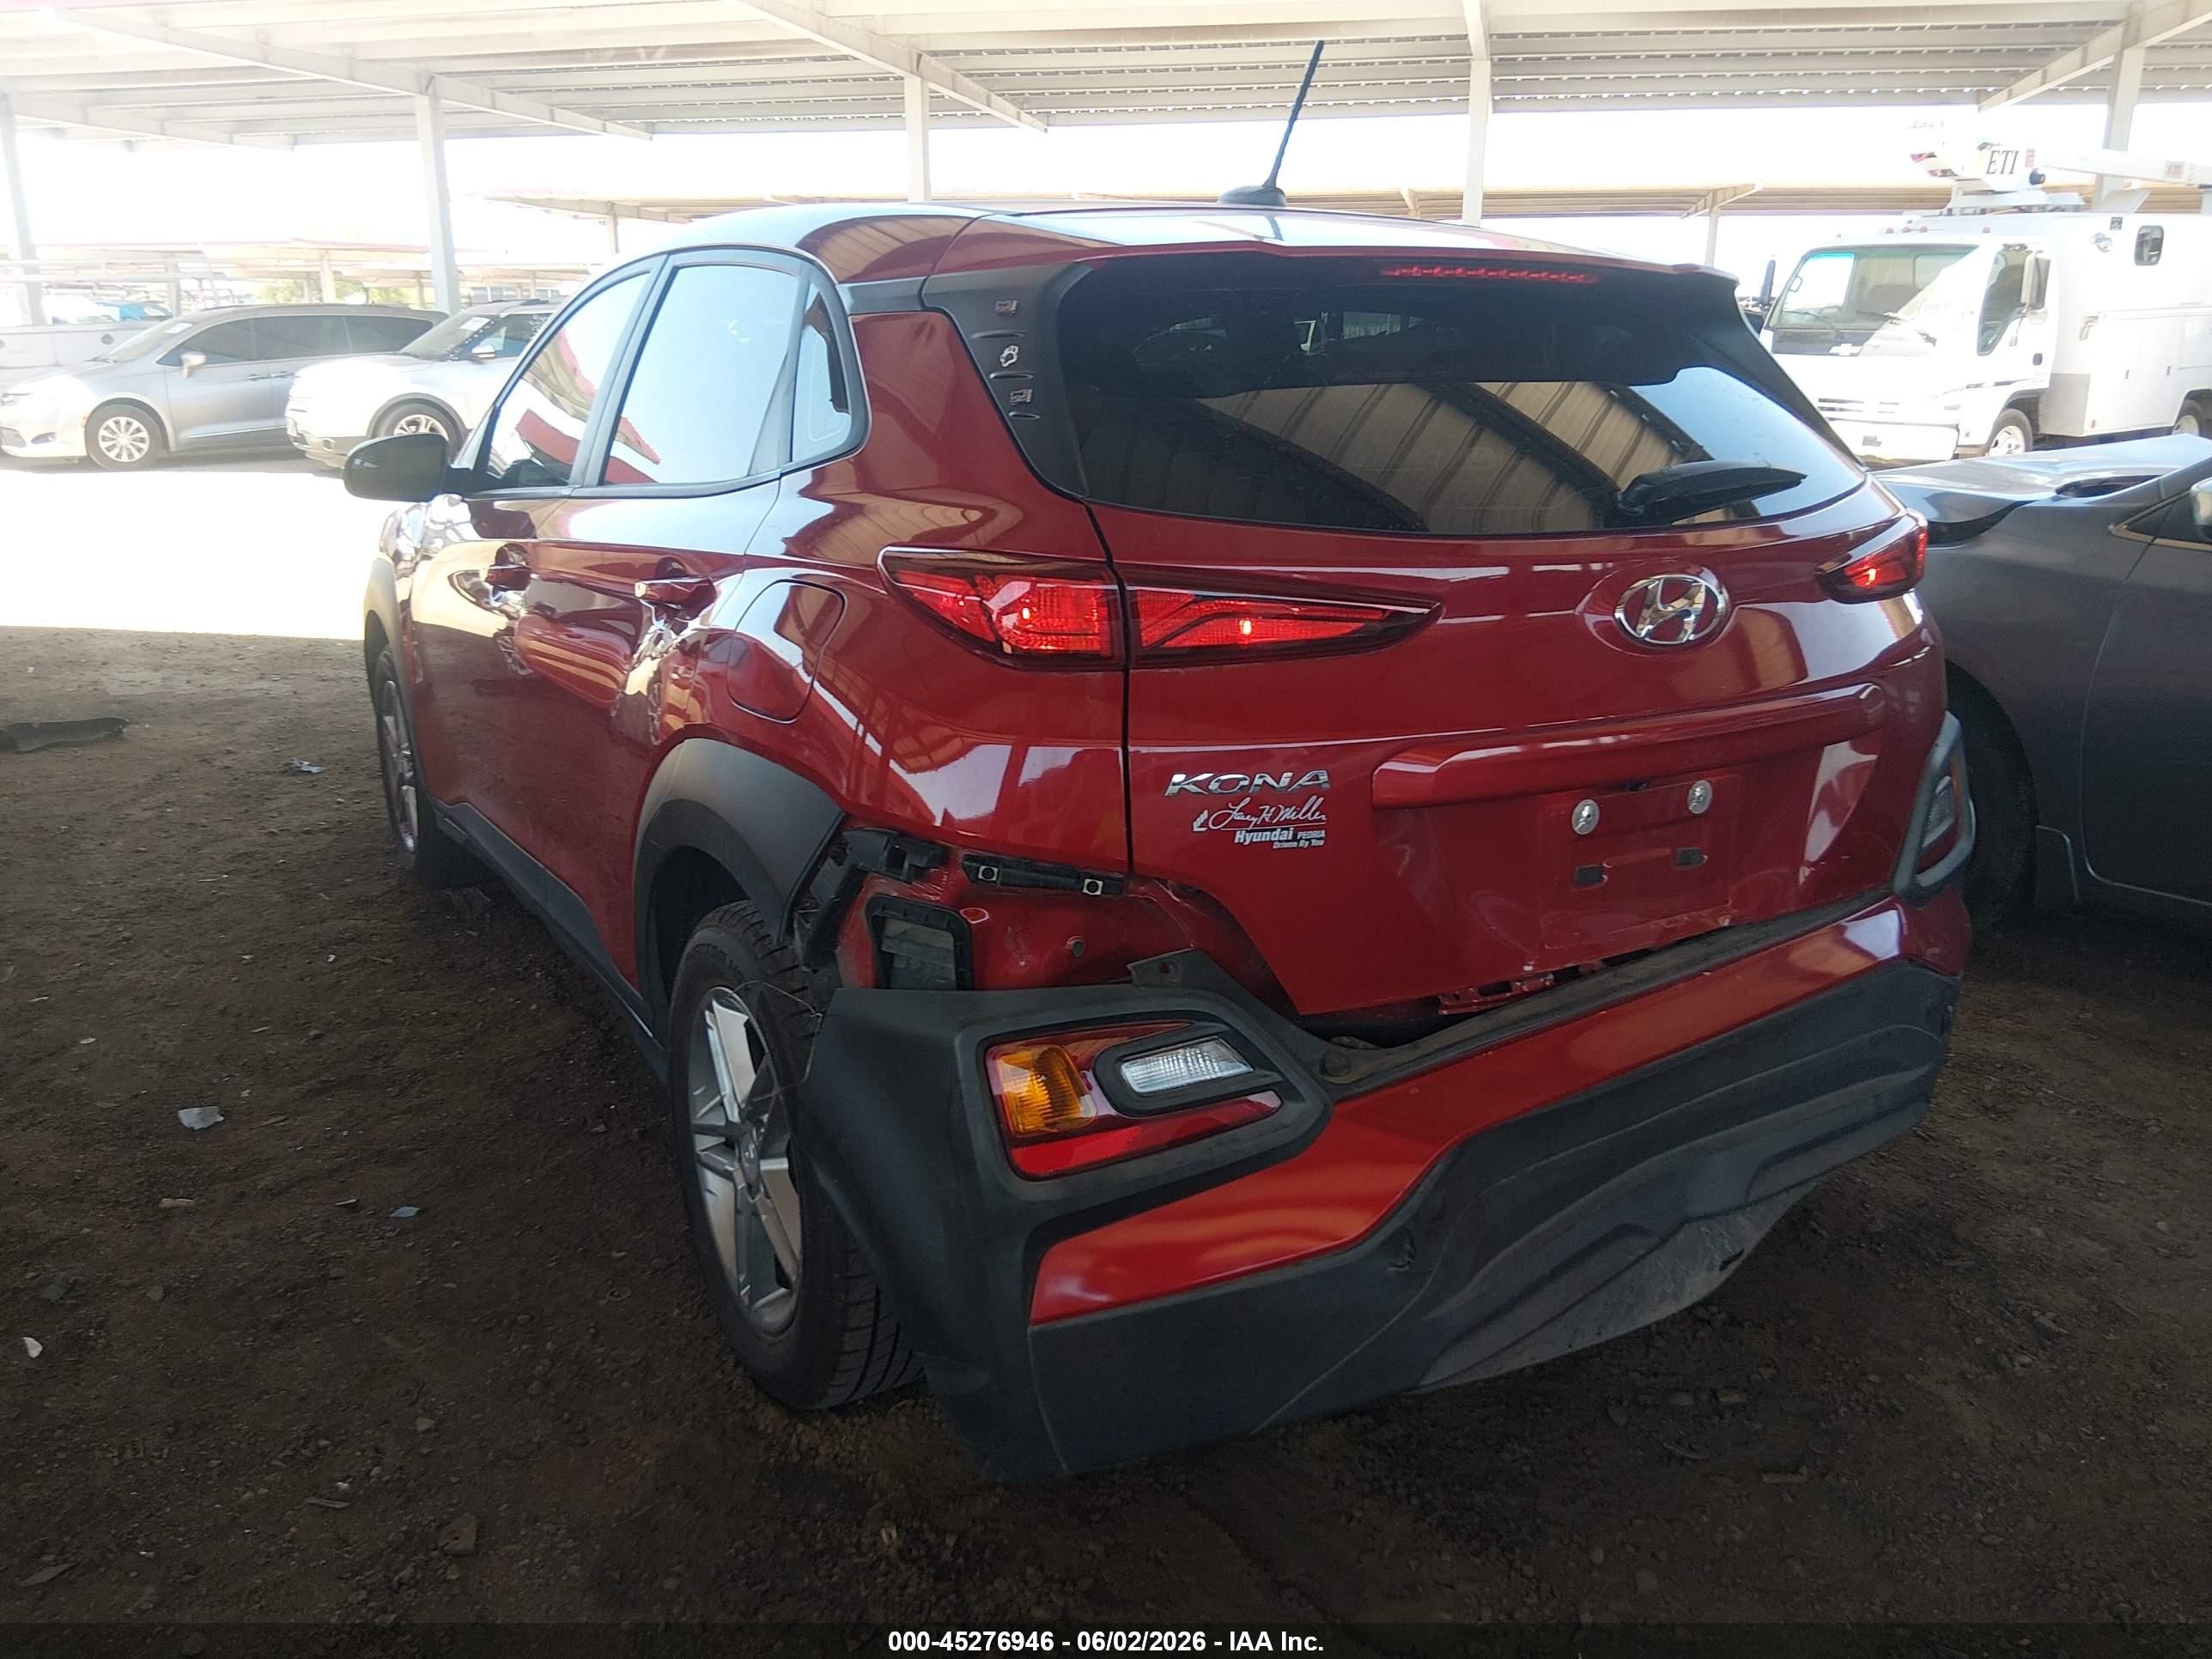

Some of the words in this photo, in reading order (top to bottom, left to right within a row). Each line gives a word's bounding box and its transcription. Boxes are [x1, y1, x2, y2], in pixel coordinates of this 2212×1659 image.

[1985, 150, 2020, 174] ETI
[1164, 770, 1330, 796] KONA
[1273, 795, 1327, 823] Miller
[1235, 828, 1293, 845] Hyundai
